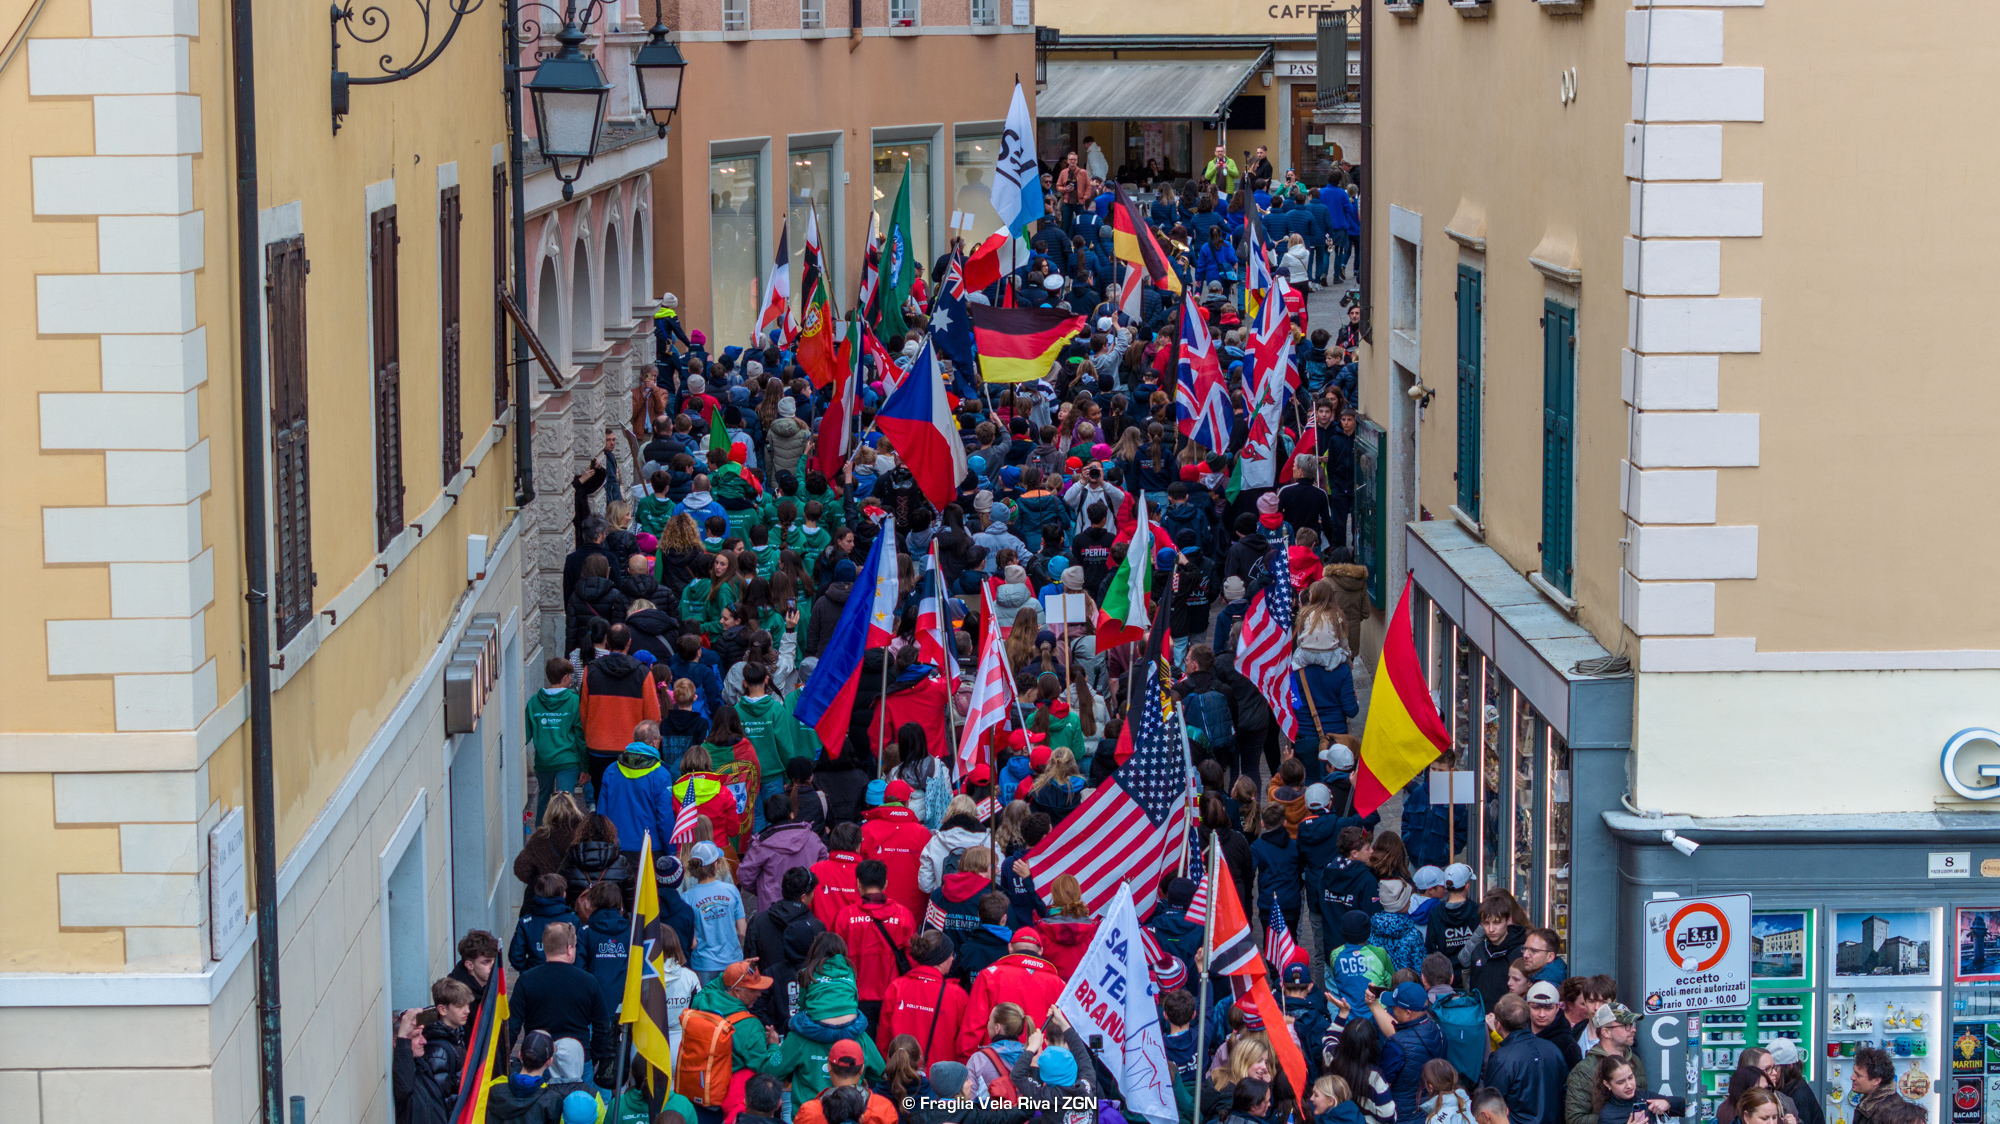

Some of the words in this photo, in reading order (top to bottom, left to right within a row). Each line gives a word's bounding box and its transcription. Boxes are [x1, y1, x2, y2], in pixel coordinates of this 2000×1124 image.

[1084, 547, 1107, 557] PERTH
[835, 853, 855, 862] MUSTO
[1945, 856, 1954, 868] 8
[695, 895, 712, 909] SALTY
[713, 894, 731, 902] CREW
[1444, 926, 1473, 939] CNA
[598, 942, 626, 954] USA
[1021, 958, 1044, 968] MUSTO
[1339, 955, 1375, 974] CGSC
[1675, 973, 1720, 986] eccetto
[1679, 985, 1702, 996] merci
[1704, 981, 1746, 993] autorizzati
[1660, 999, 1682, 1010] rario
[1953, 1060, 1983, 1069] MARTINI
